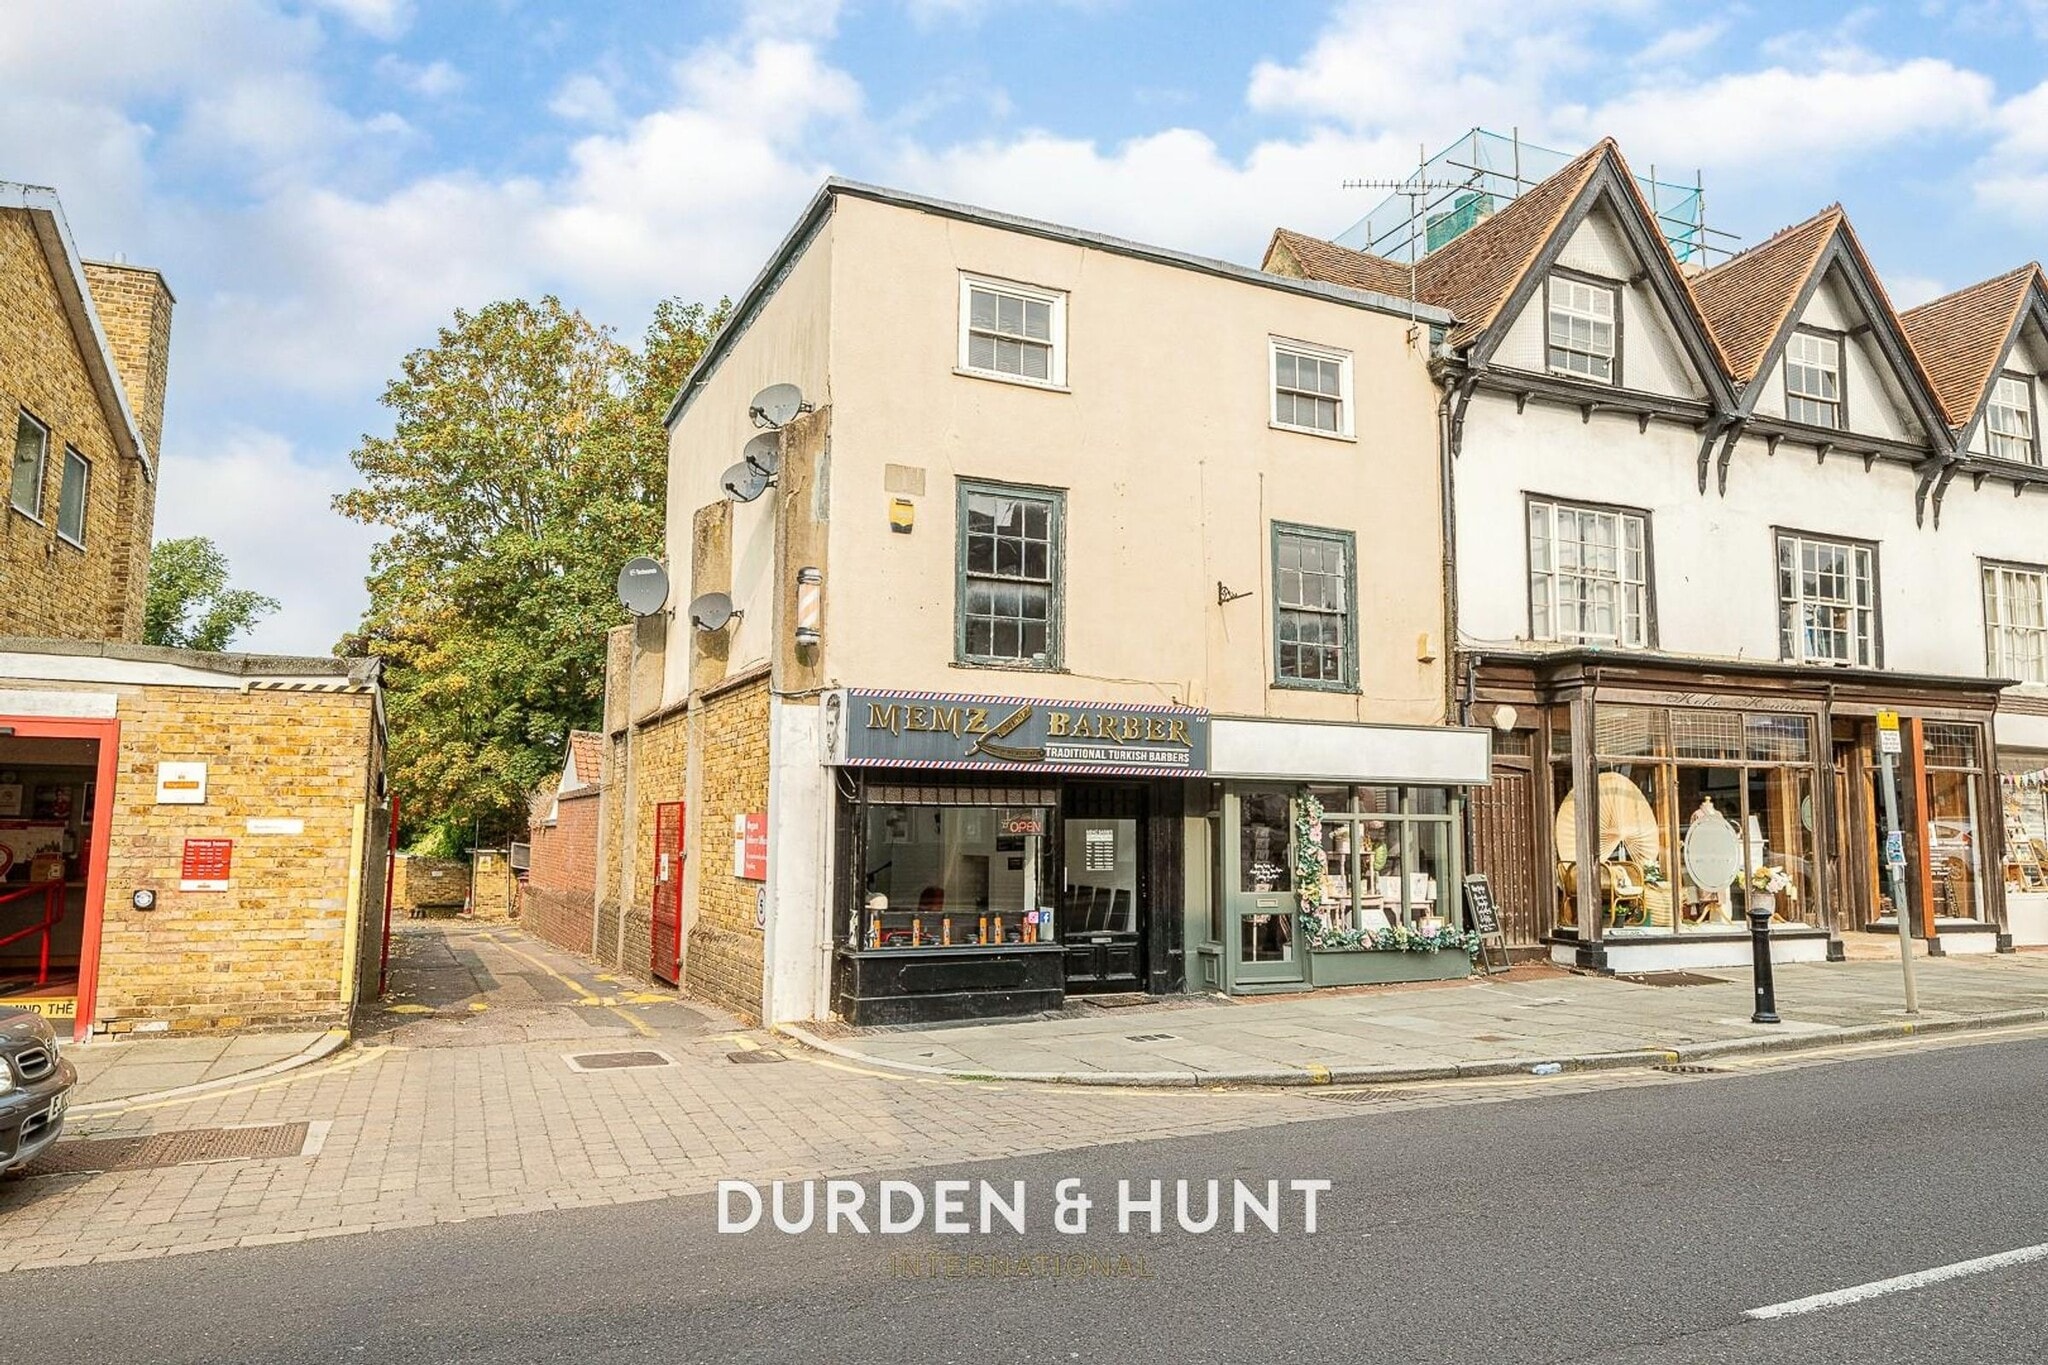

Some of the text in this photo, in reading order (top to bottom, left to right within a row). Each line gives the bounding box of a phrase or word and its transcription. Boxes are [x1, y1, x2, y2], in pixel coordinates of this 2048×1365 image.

[866, 703, 1193, 748] MEMZ BARBER
[1045, 746, 1106, 760] TRADITIONAL
[1109, 750, 1147, 762] TURKISH
[1149, 752, 1190, 763] BARBERS
[1010, 821, 1041, 833] OPEN
[48, 1003, 74, 1015] THE
